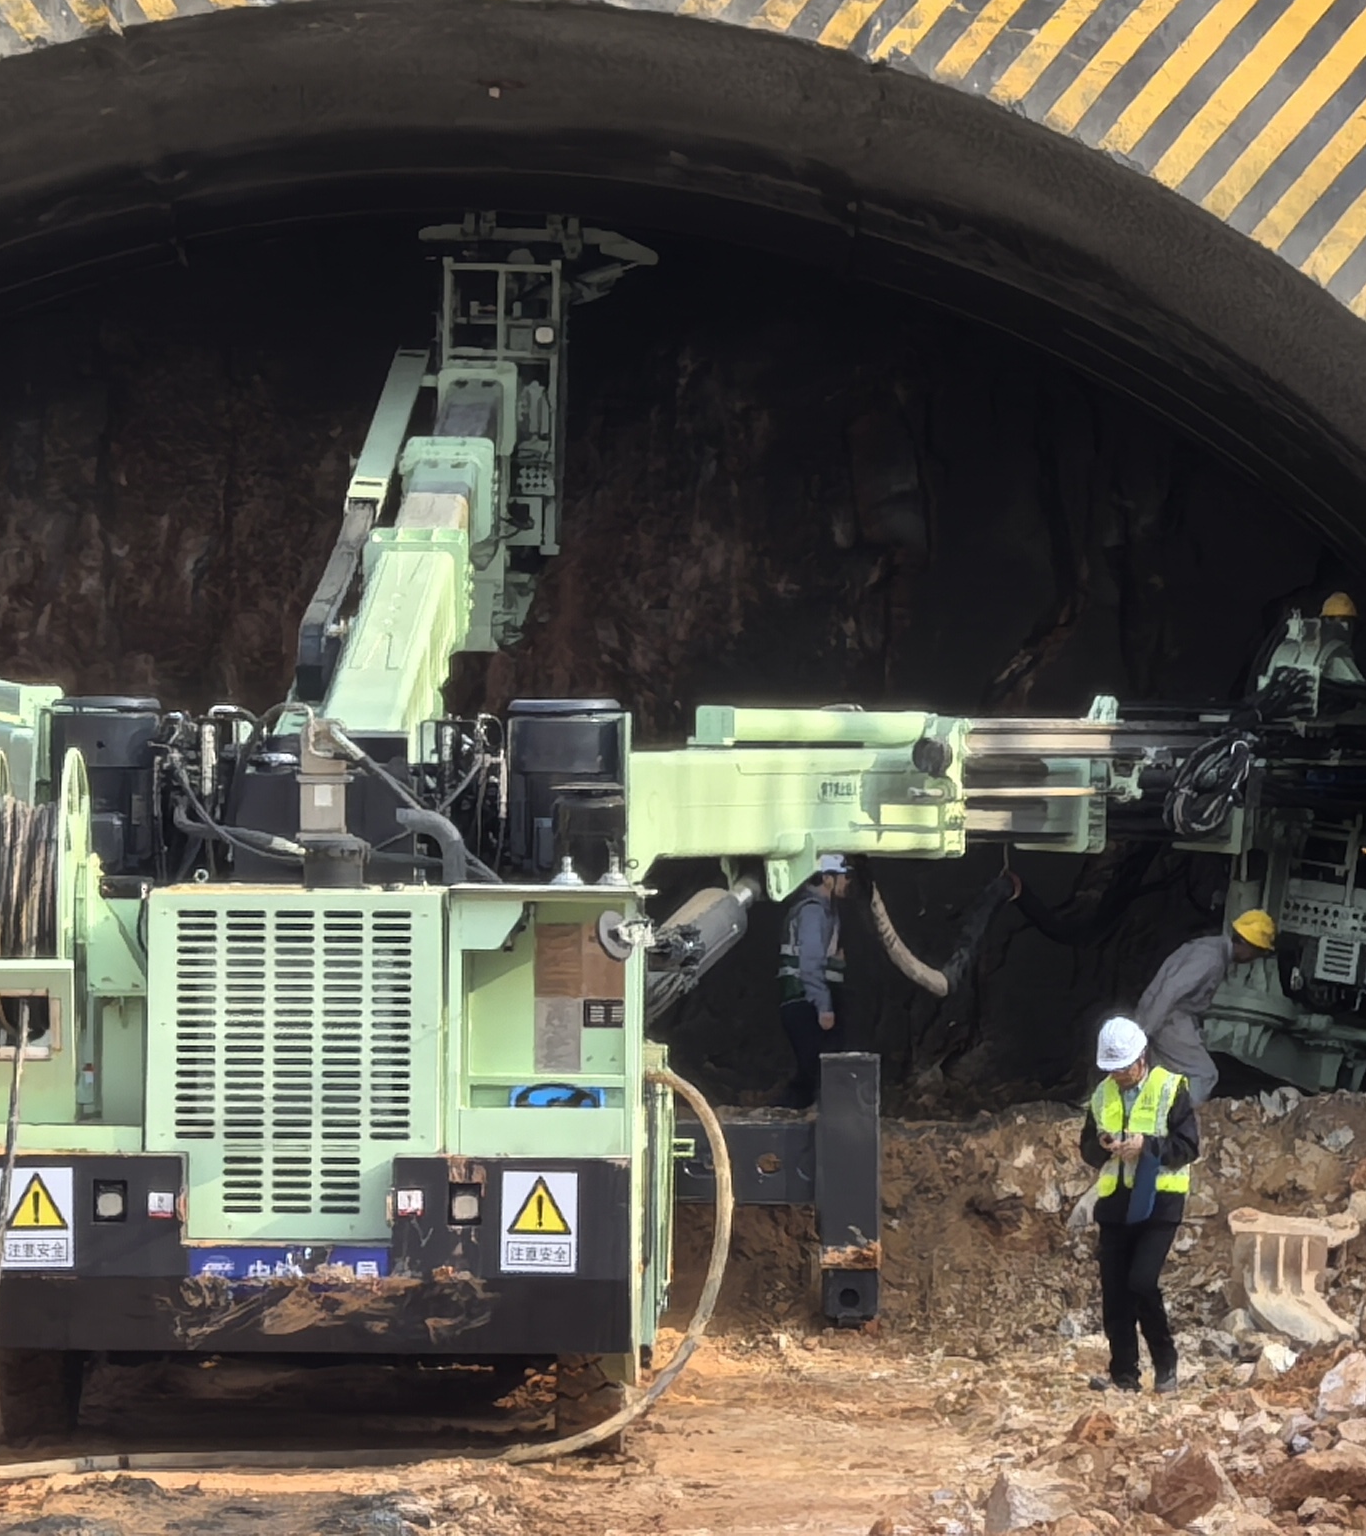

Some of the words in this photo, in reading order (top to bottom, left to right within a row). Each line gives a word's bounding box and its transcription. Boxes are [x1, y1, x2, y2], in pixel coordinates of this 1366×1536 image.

[8, 1241, 66, 1259] 注意安全
[510, 1246, 568, 1263] 注意安全
